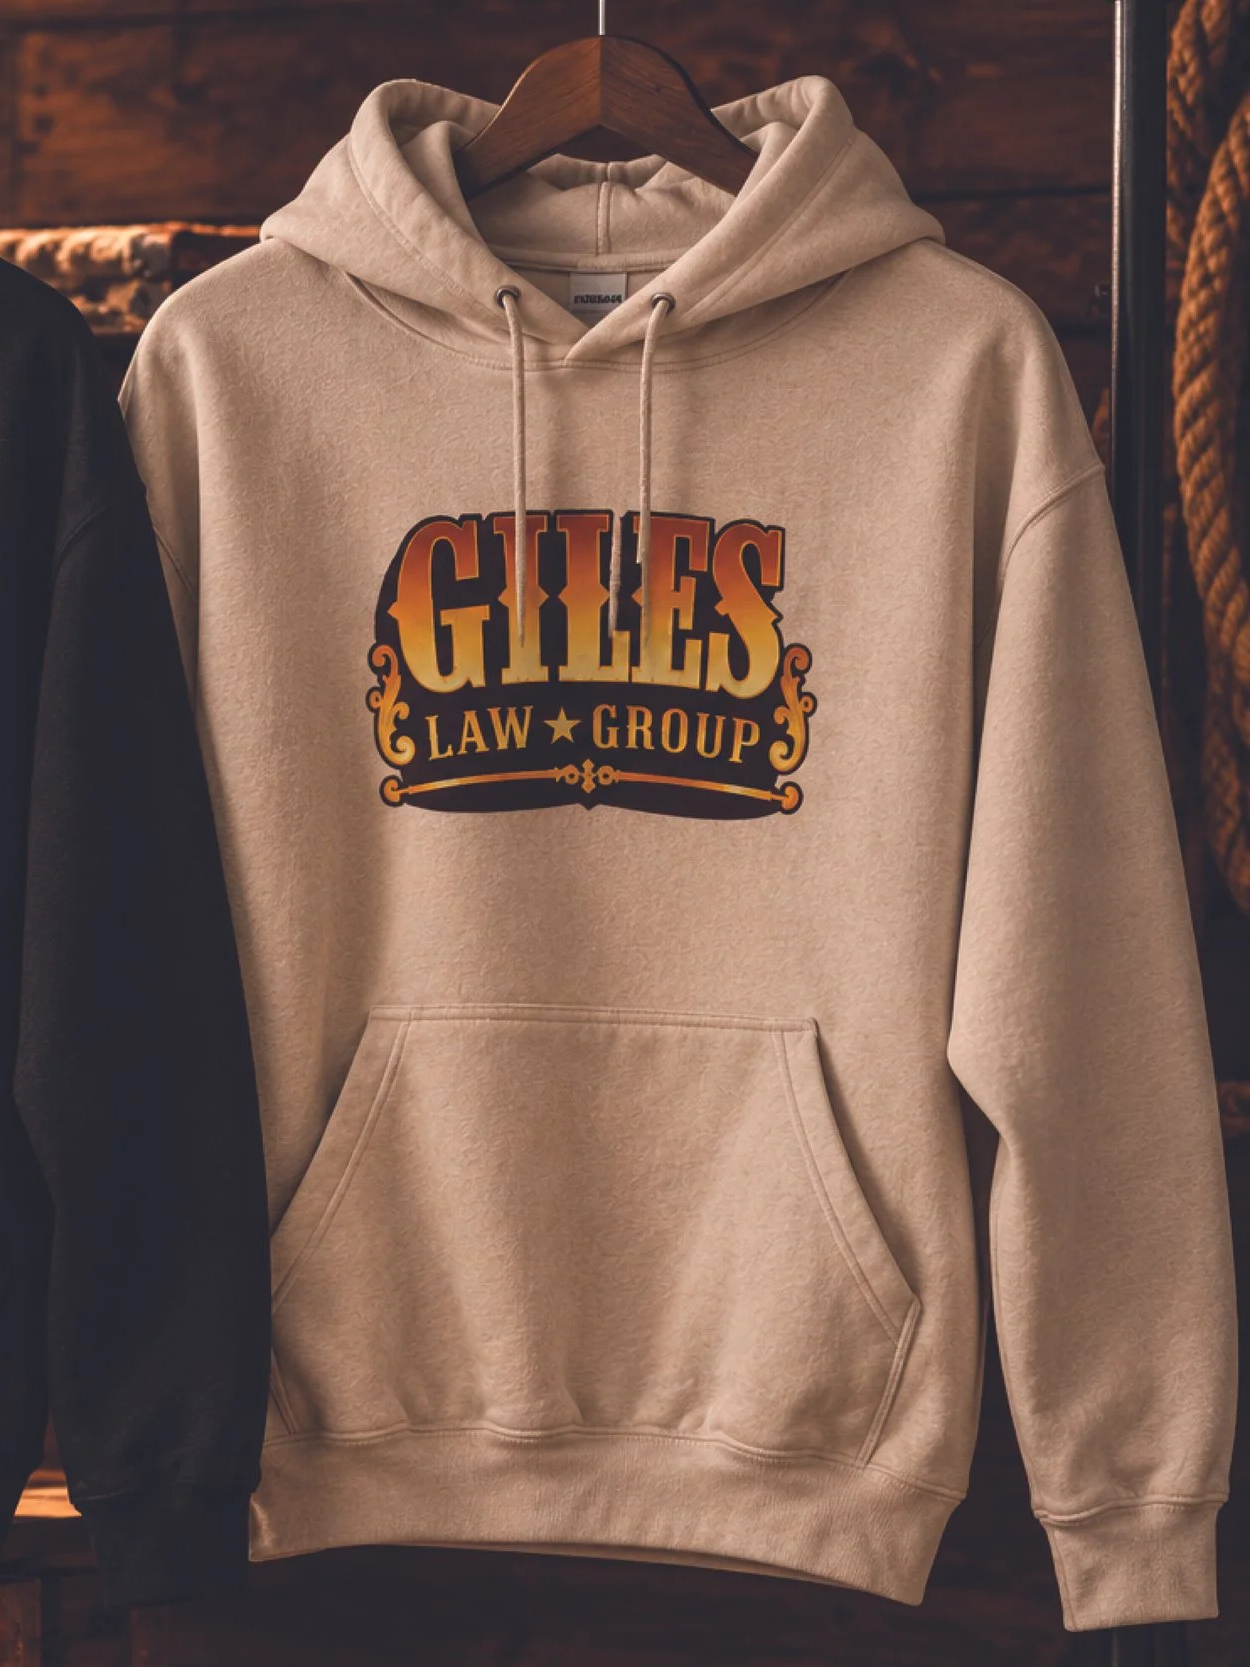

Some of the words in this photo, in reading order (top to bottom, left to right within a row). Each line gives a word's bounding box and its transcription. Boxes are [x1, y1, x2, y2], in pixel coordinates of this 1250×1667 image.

[386, 514, 784, 699] GILES
[425, 705, 534, 761] LAW
[592, 703, 762, 763] GROUP
